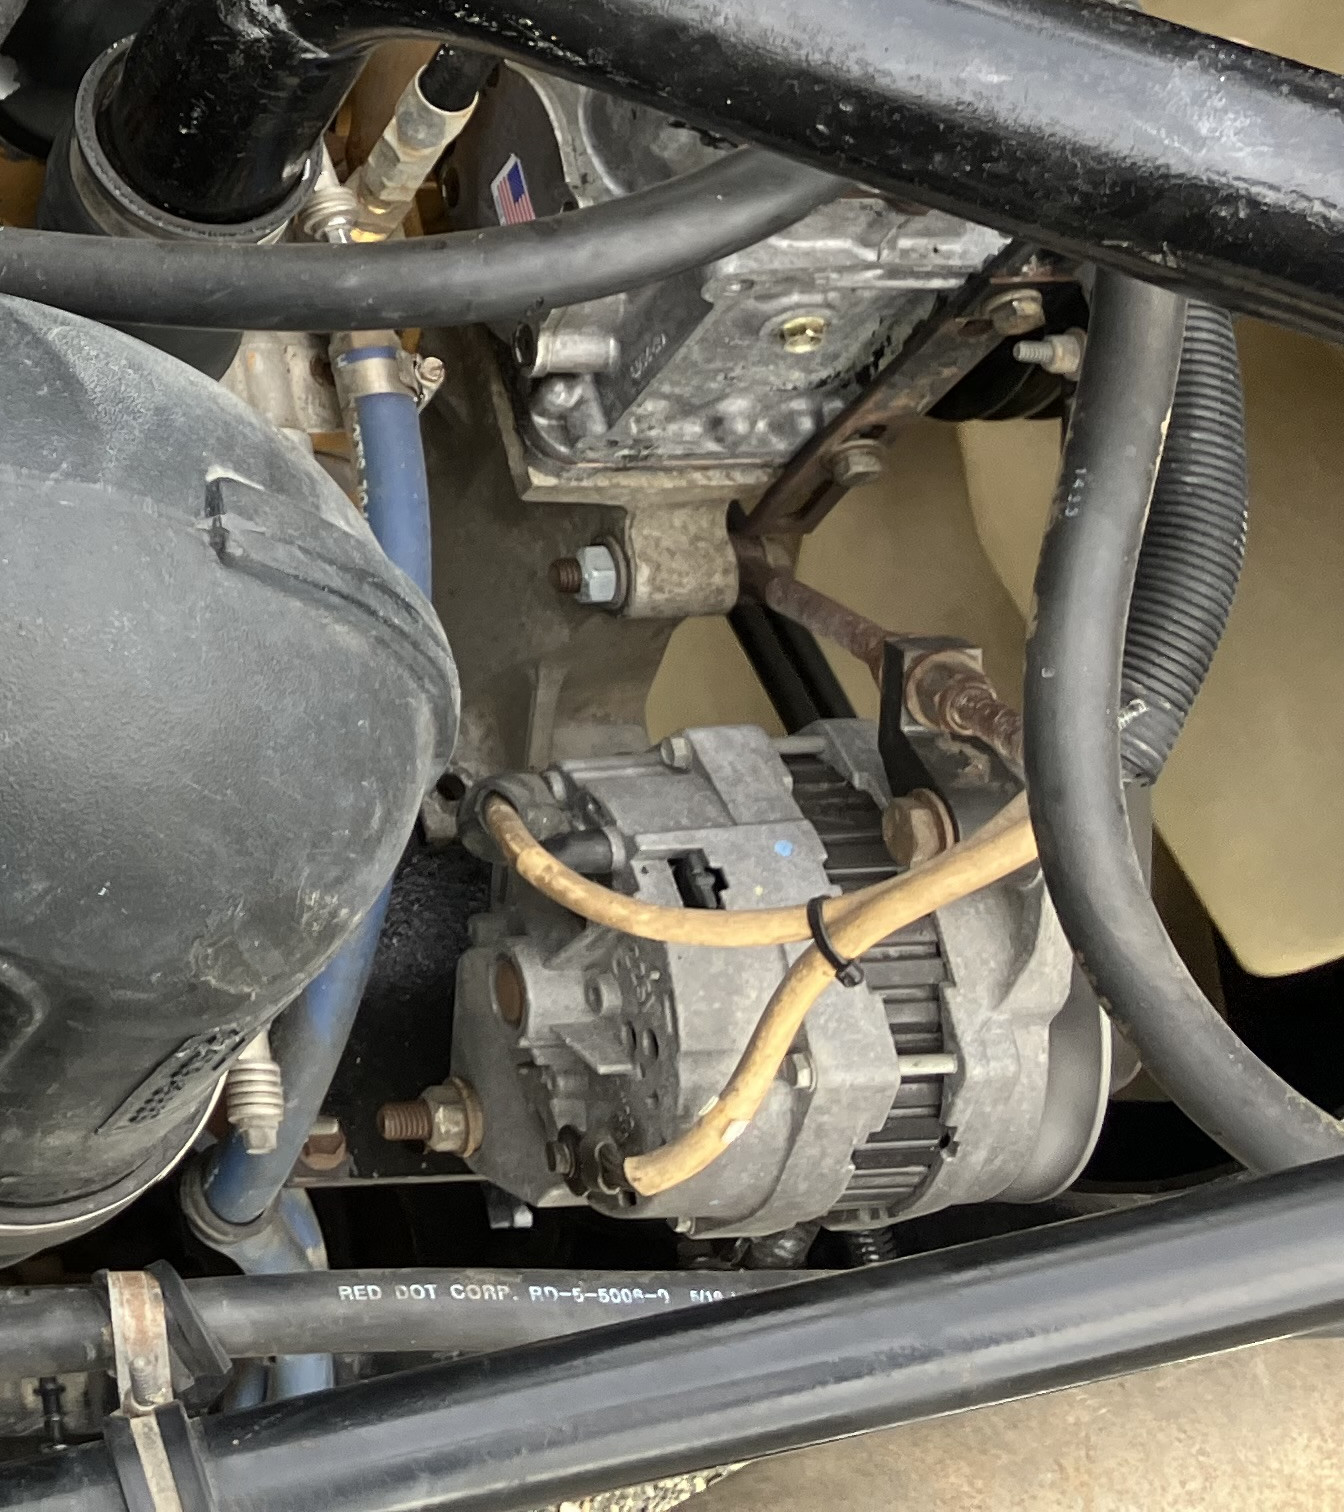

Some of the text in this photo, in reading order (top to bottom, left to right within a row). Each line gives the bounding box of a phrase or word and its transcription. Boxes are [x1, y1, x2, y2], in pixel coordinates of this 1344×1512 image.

[338, 1284, 383, 1302] RED
[394, 1284, 438, 1301] DOT
[450, 1284, 519, 1302] CORP.
